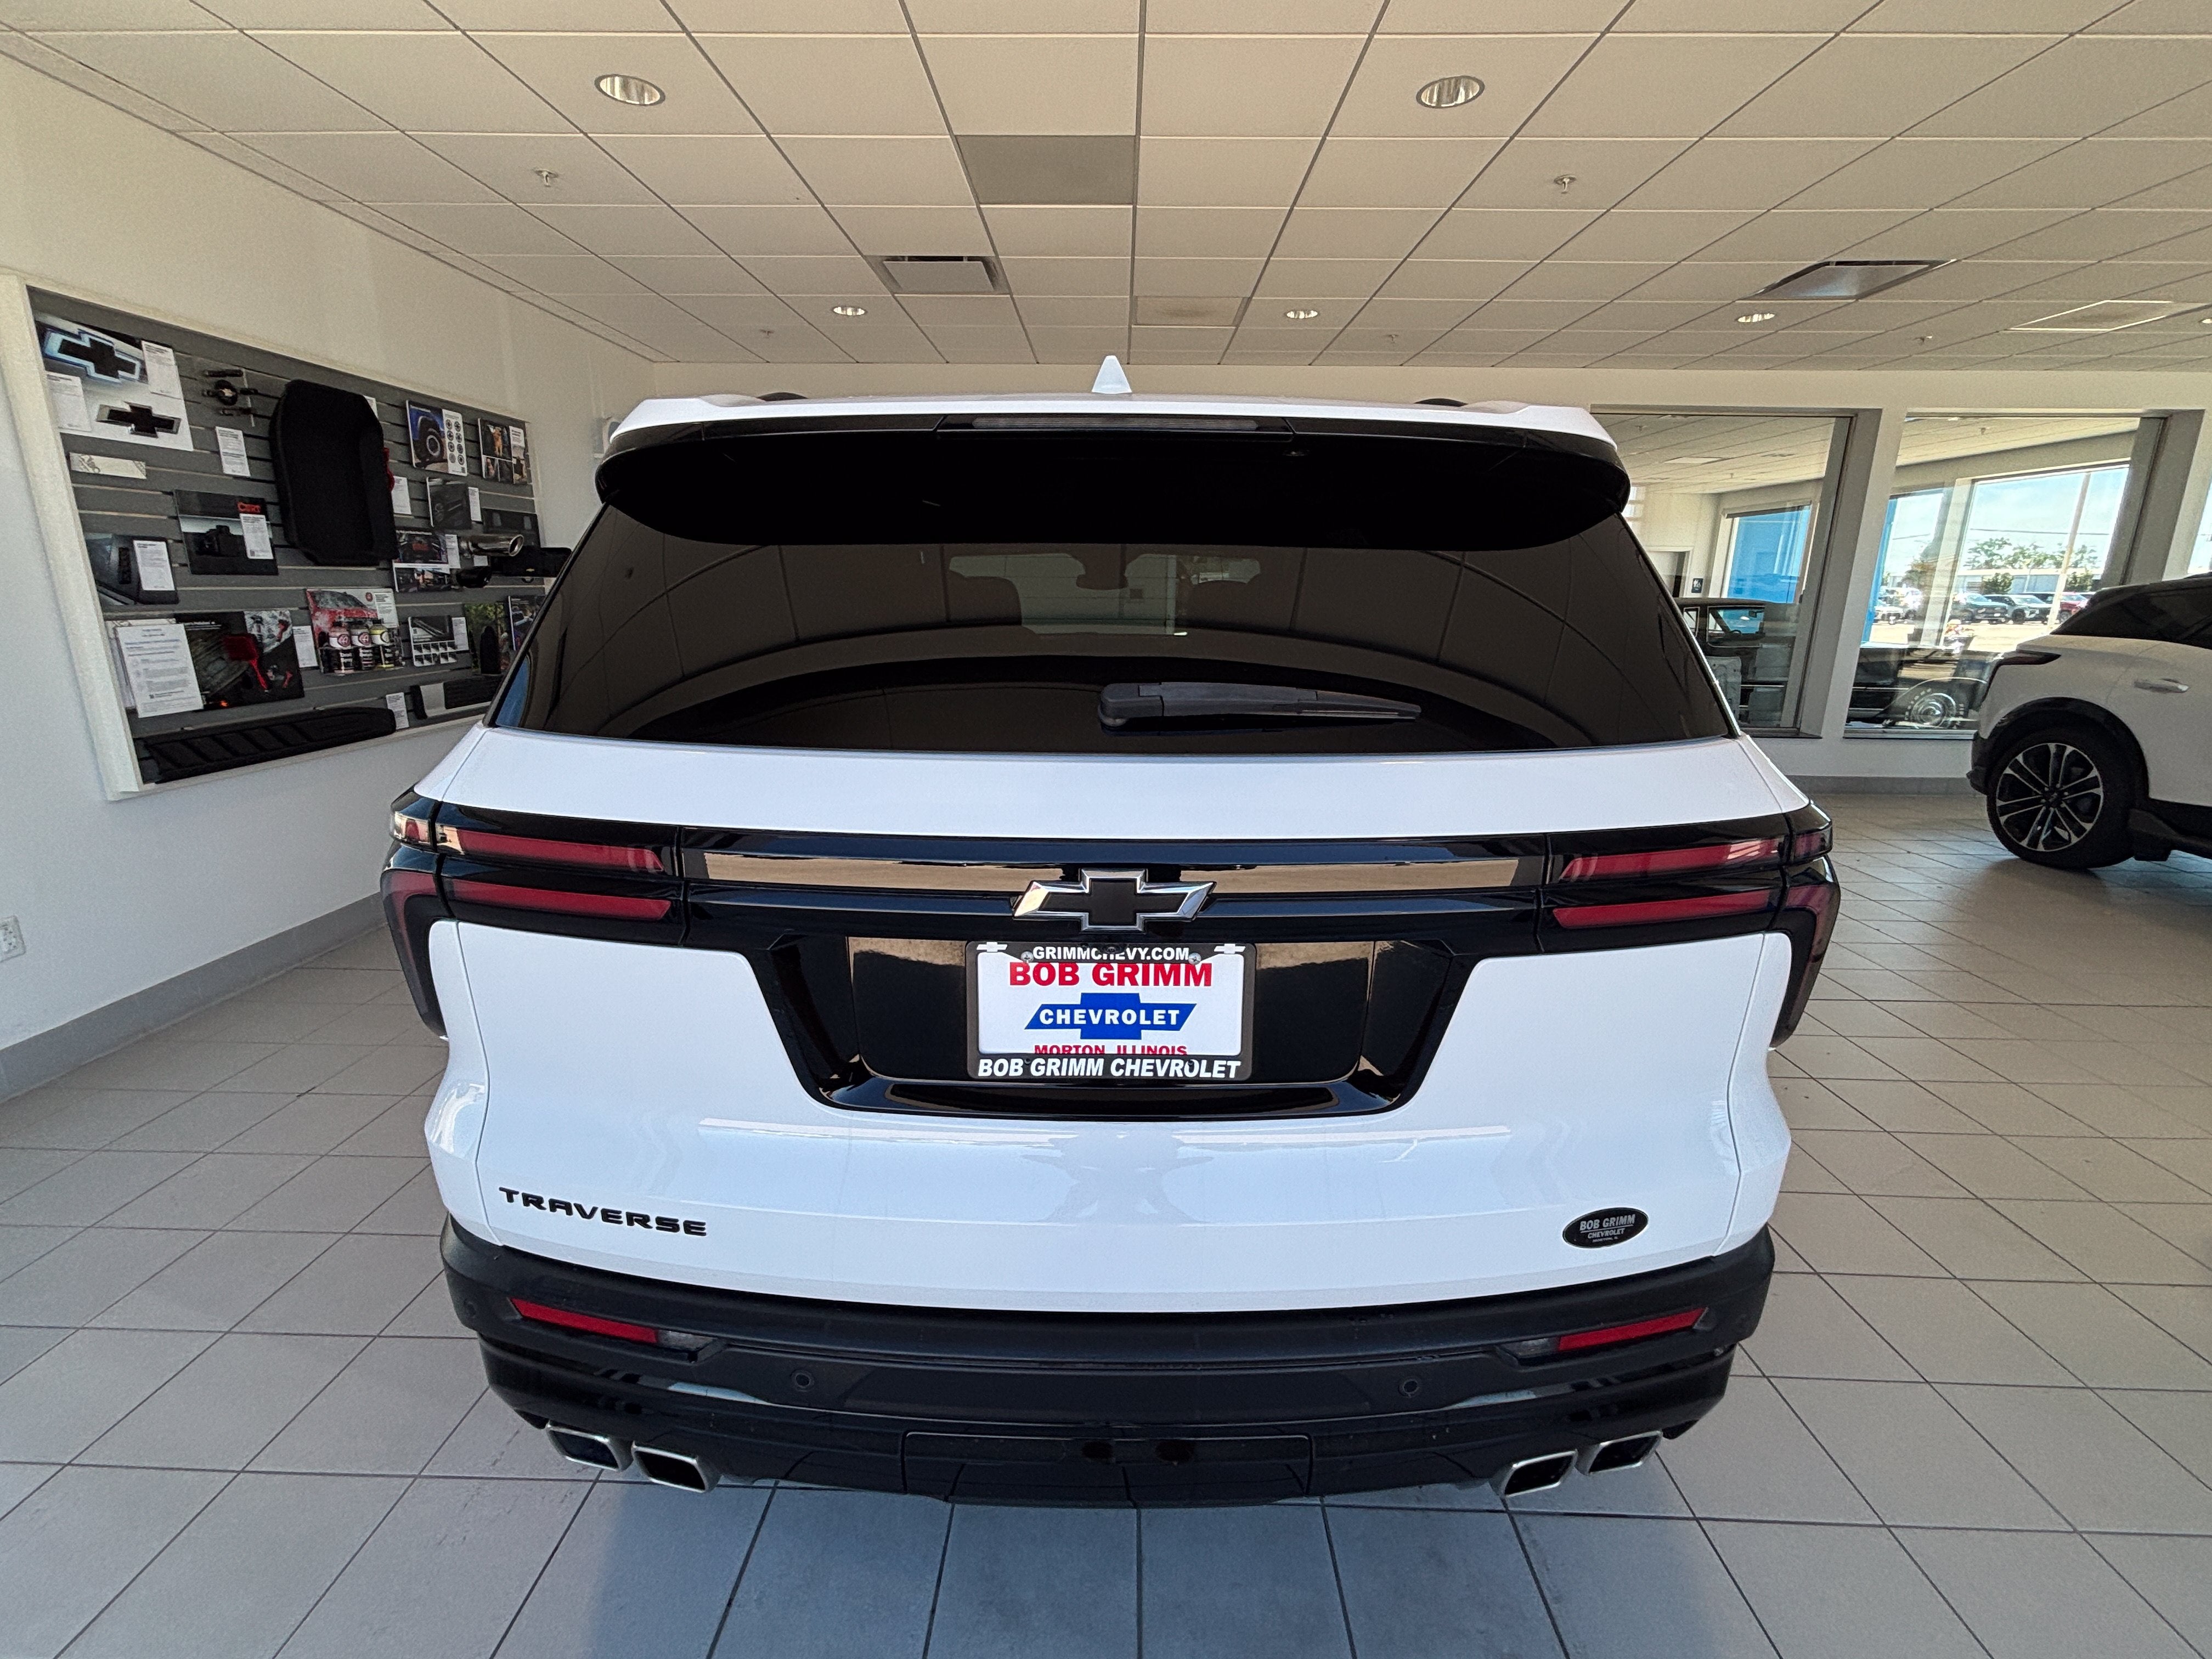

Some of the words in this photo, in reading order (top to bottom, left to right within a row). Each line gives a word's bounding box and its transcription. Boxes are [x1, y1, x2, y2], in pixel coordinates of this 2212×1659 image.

[1009, 962, 1080, 986] BOB
[1092, 962, 1212, 987] GRIMM
[1039, 1009, 1180, 1025] CHEVROLET
[1034, 1045, 1105, 1055] MORTON
[978, 1058, 1024, 1077] BOB
[1030, 1058, 1105, 1077] GRIMM
[1110, 1058, 1241, 1079] CHEVROLET
[498, 1186, 707, 1237] TRAVERSE
[1579, 1219, 1600, 1231] BOB
[1602, 1214, 1636, 1228] GRIMM
[1587, 1228, 1626, 1239] CHEVROLET
